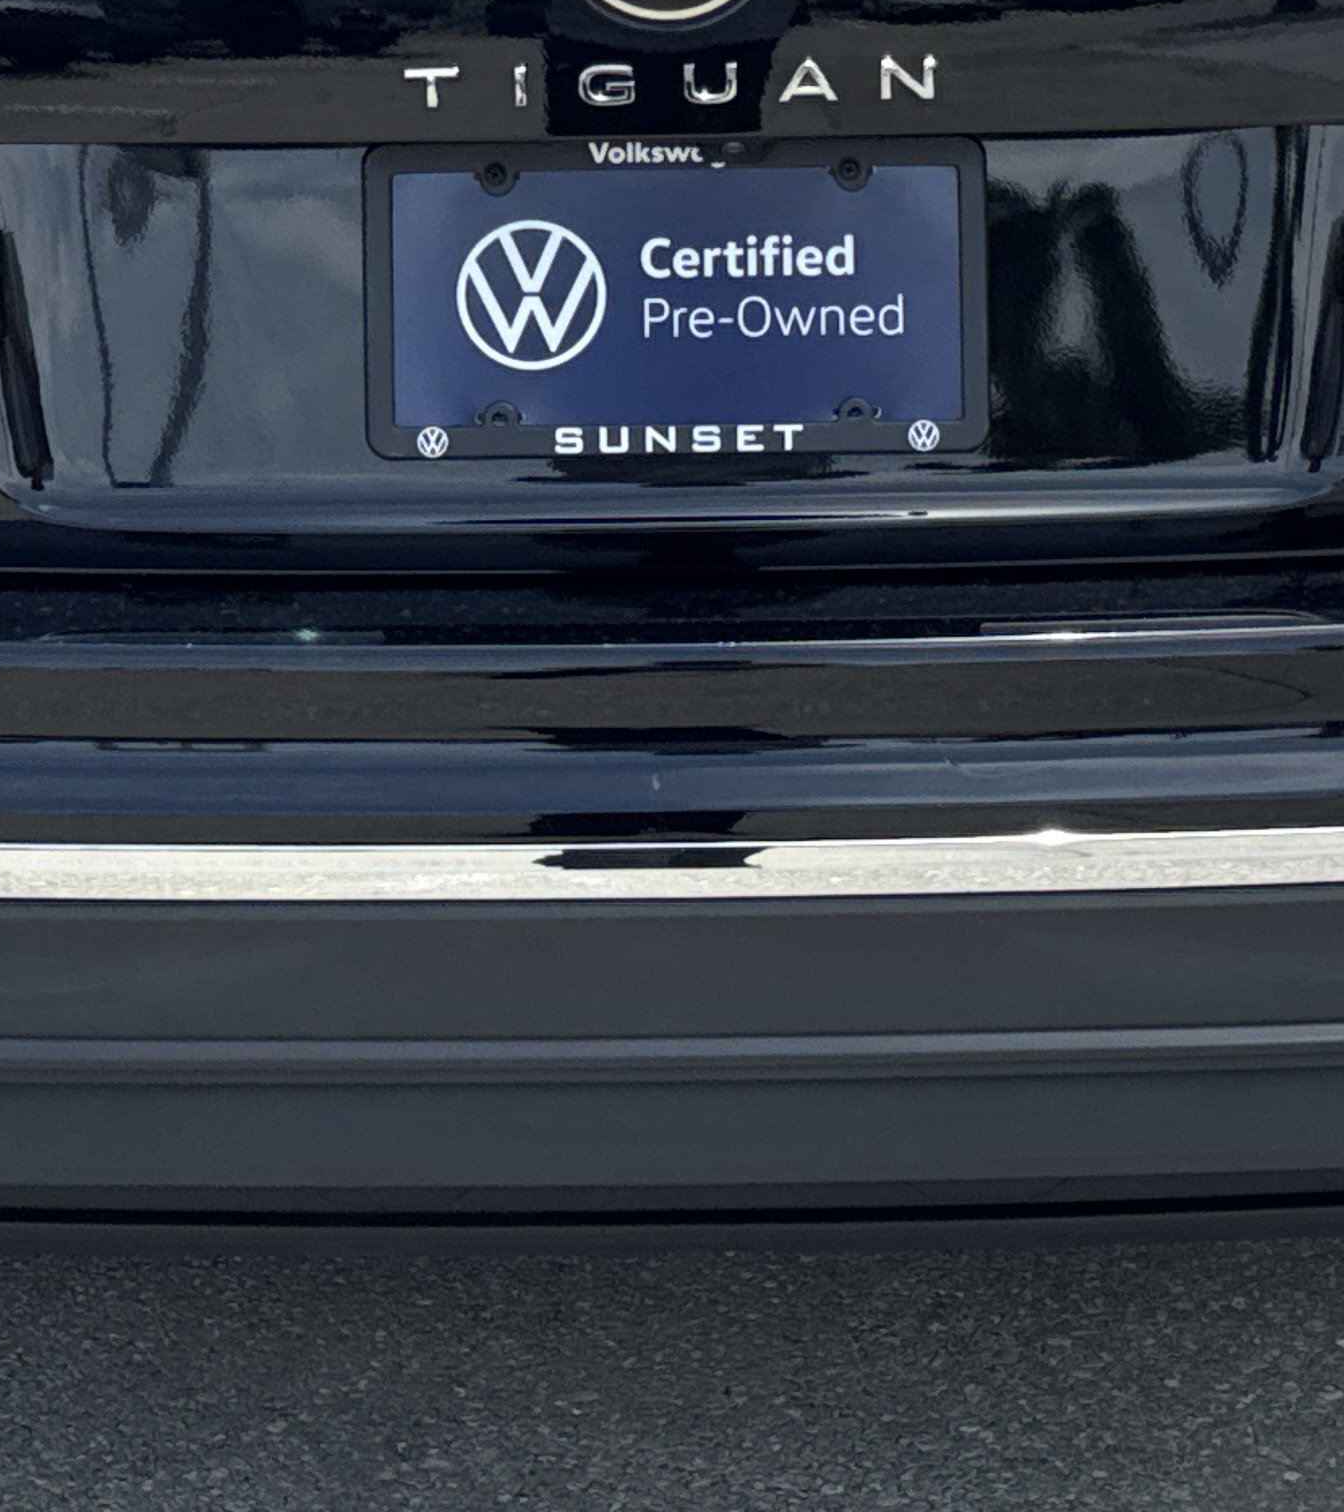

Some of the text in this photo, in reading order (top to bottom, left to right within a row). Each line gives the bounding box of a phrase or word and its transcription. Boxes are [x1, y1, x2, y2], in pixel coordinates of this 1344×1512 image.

[404, 54, 938, 108] TIGUAN
[640, 234, 855, 279] Certified
[642, 293, 905, 338] Pre-Owned
[554, 424, 804, 454] SUNSET
